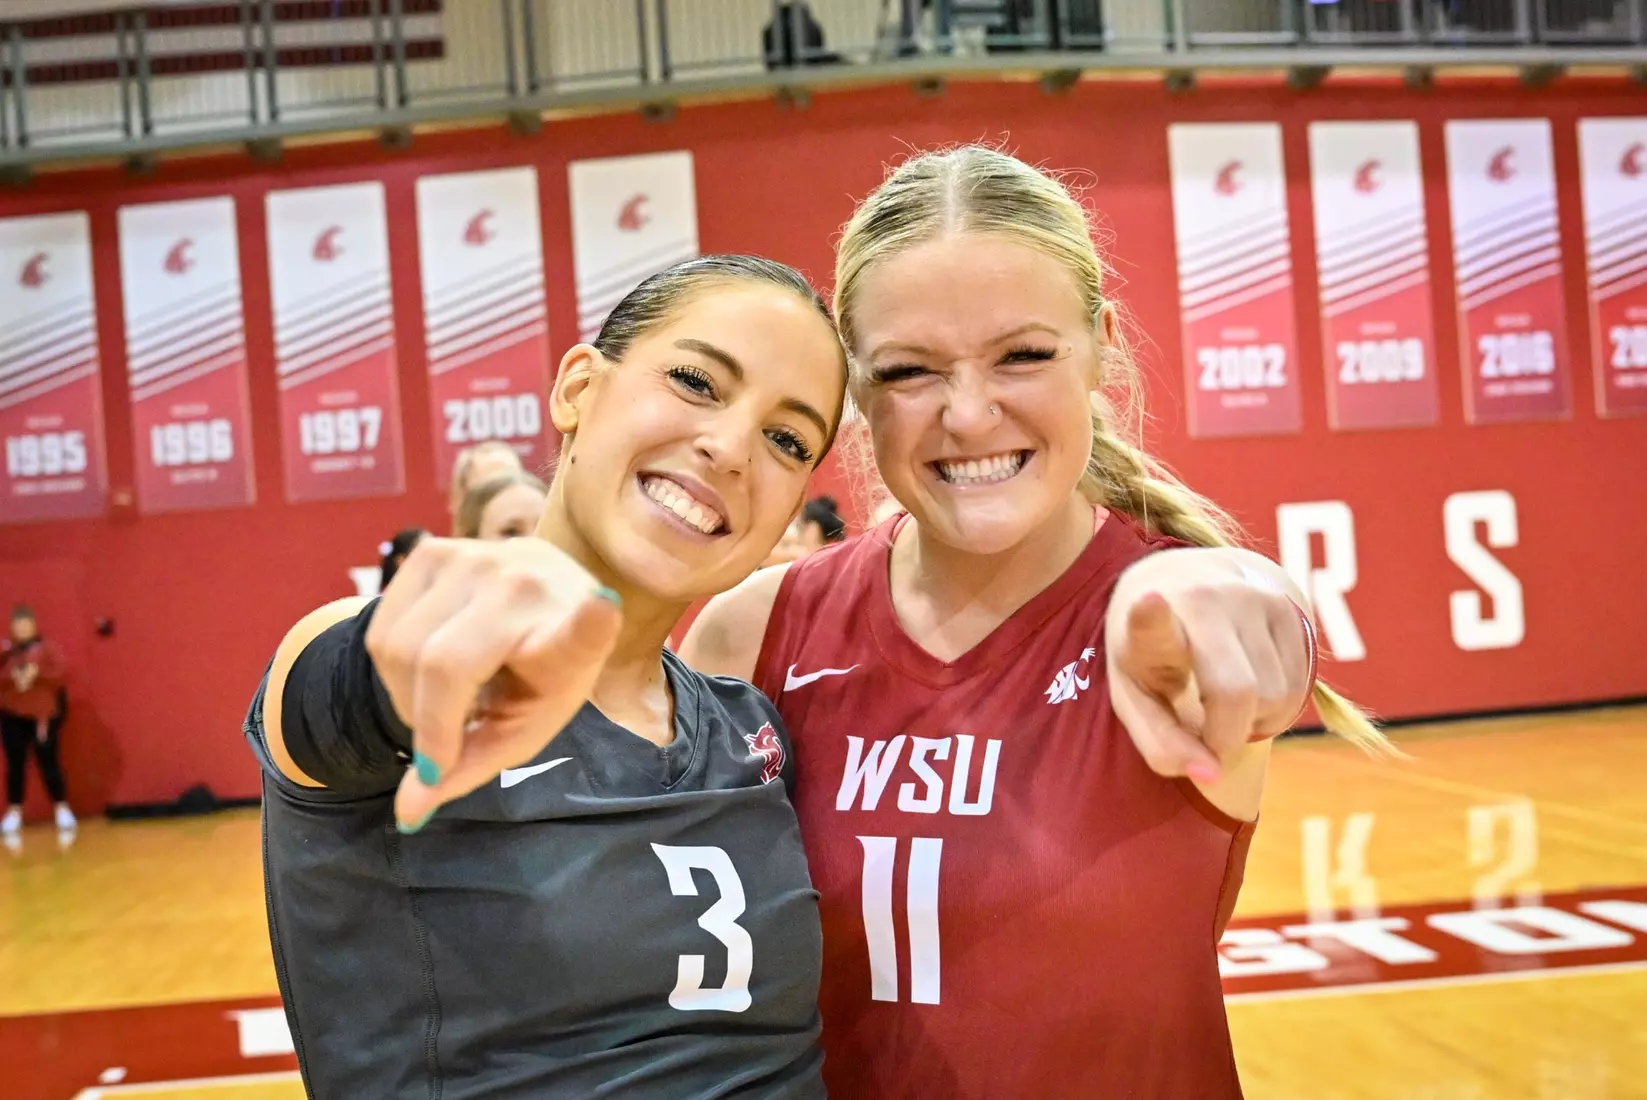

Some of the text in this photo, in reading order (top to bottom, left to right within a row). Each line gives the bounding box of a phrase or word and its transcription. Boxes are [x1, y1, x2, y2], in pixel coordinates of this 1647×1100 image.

[1197, 344, 1286, 390] 2002
[1336, 338, 1425, 383] 2009
[299, 407, 381, 454] 1997
[443, 393, 542, 443] 2000
[6, 431, 87, 476] 1995
[150, 419, 234, 466] 1996
[835, 733, 1003, 816] WSU
[650, 842, 754, 1013] 3
[854, 834, 944, 1005] 11
